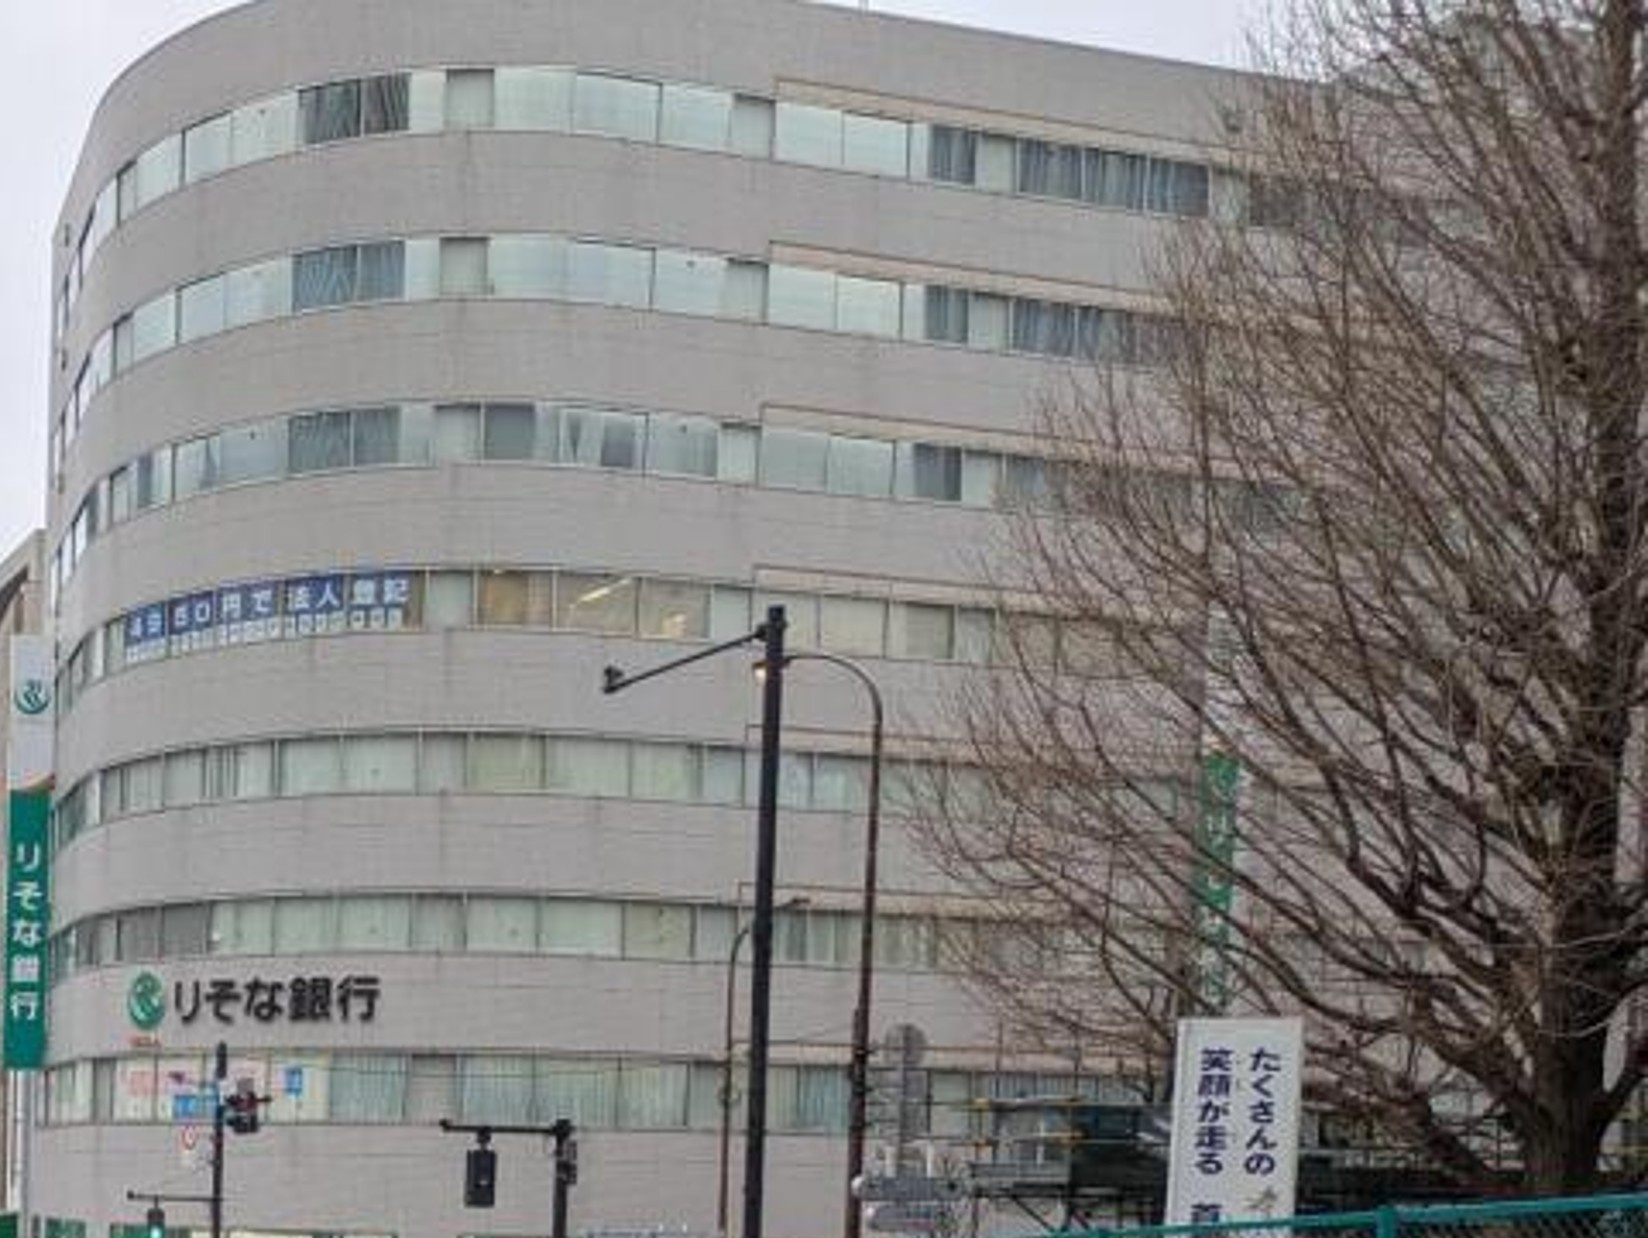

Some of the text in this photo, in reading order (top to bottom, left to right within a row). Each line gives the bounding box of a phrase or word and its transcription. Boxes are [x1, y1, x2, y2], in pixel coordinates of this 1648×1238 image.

[10, 842, 43, 1021] りそな銀行
[174, 976, 380, 1024] りそな銀行
[1195, 1047, 1234, 1174] 笑顔が走る
[1243, 1047, 1281, 1175] たくさんの
